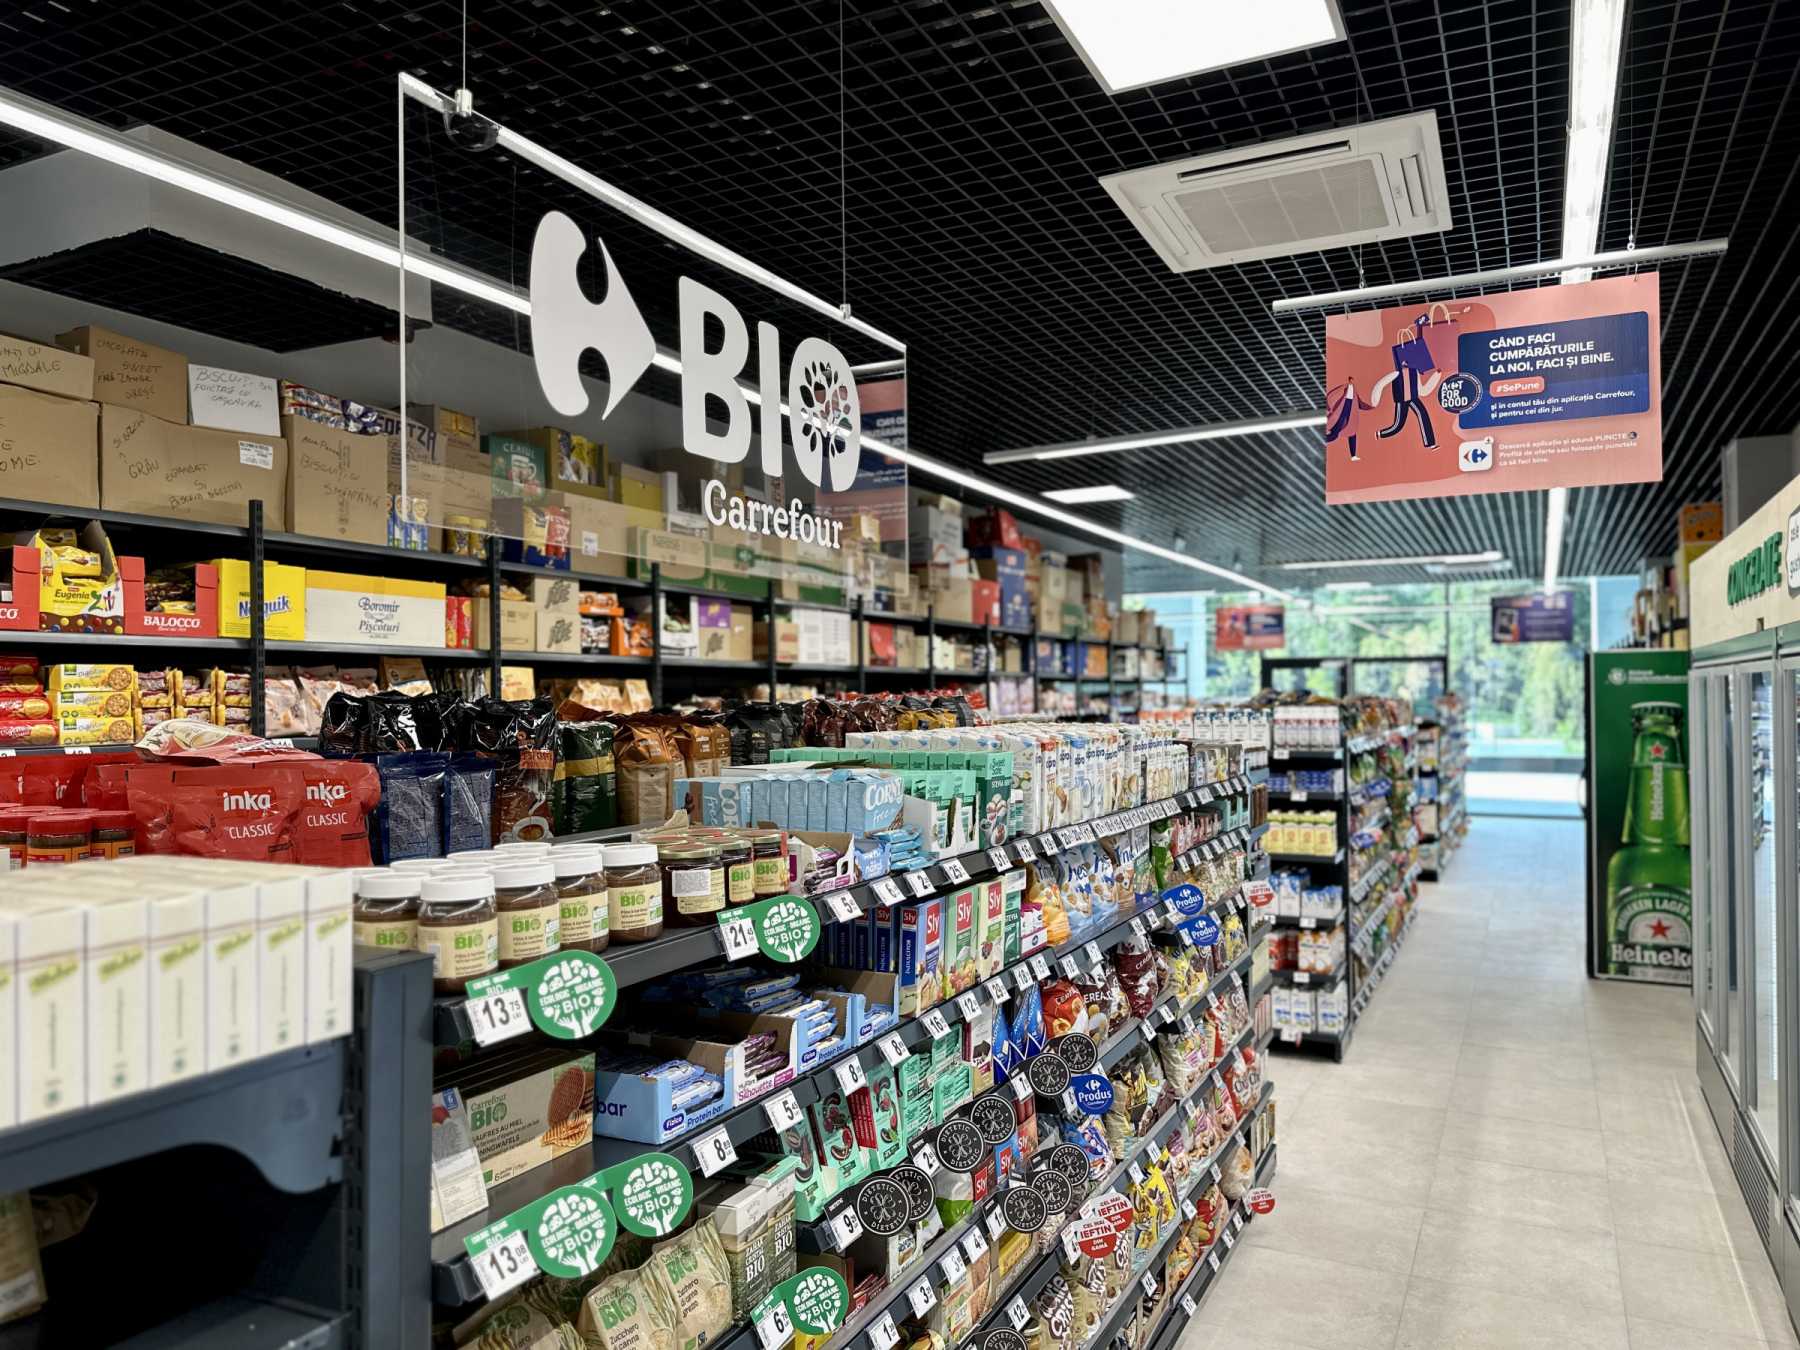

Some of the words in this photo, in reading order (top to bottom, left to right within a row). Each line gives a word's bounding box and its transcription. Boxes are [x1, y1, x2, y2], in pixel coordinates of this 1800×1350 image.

[1489, 336, 1525, 350] CÂND
[1527, 332, 1556, 345] FACI
[1489, 340, 1595, 363] CUMPĂRĂTURILE
[1490, 364, 1505, 375] LA
[1507, 362, 1533, 373] NOI,
[1536, 357, 1564, 370] FACI
[1565, 356, 1578, 369] ȘI
[1581, 352, 1614, 365] BINE.
[679, 275, 860, 492] BIO
[1495, 381, 1540, 393] #SePune
[1441, 389, 1460, 399] FOR
[1441, 396, 1468, 408] GOOD
[1498, 409, 1524, 419] pentru
[704, 479, 843, 550] Carrefour
[54, 589, 90, 600] Eugenia
[358, 597, 401, 613] Boromir
[144, 616, 200, 628] BALOCCO
[306, 780, 347, 803] nka
[223, 790, 272, 812] inka
[306, 812, 348, 828] CLASSIC
[228, 823, 274, 840] CLASSIC
[731, 868, 750, 882] BIO
[756, 862, 779, 875] BIO
[952, 865, 963, 881] 25
[885, 883, 897, 899] 6
[917, 874, 928, 890] 2
[619, 893, 646, 907] BIO
[841, 896, 853, 914] 5
[989, 890, 1002, 914] Sly
[1176, 894, 1202, 909] Produs
[560, 904, 589, 919] BIO
[903, 910, 917, 923] Sly
[957, 902, 972, 925] Sly
[512, 918, 542, 933] BIO
[927, 911, 940, 935] Sly
[375, 932, 408, 946] BIO
[729, 922, 748, 948] 21
[780, 930, 804, 945] BIO
[1191, 925, 1217, 940] Produs
[454, 934, 485, 950] BIO
[482, 996, 510, 1030] 13
[510, 1000, 521, 1011] 75
[563, 994, 591, 1014] BIO
[965, 997, 977, 1015] 12
[929, 1016, 944, 1033] 16
[891, 1039, 901, 1057] 8
[849, 1064, 858, 1083] 8
[1033, 1057, 1059, 1072] DIETETIC
[471, 1093, 507, 1112] Carrefour
[1078, 1089, 1112, 1103] Produs
[471, 1103, 507, 1131] BIO
[687, 1109, 712, 1128] Protein
[711, 1103, 724, 1117] bar
[783, 1099, 794, 1122] 5
[975, 1100, 1002, 1117] DIETETIC
[473, 1127, 500, 1142] AUFRES
[500, 1122, 510, 1133] AU
[941, 1124, 970, 1143] DIETETIC
[984, 1124, 1012, 1141] DIETETIC
[713, 1137, 725, 1162] 8
[922, 1151, 934, 1171] 2
[951, 1149, 980, 1170] DIETETIC
[1001, 1155, 1011, 1171] Sly
[976, 1175, 987, 1193] Sly
[1036, 1174, 1063, 1187] DIETETIC
[862, 1183, 896, 1203] DIETETIC
[1008, 1191, 1037, 1205] DIETETIC
[645, 1193, 671, 1213] BIO
[1098, 1200, 1129, 1217] IEFTIN
[843, 1214, 854, 1233] 9
[871, 1212, 905, 1231] DIETETIC
[1014, 1214, 1042, 1230] DIETETIC
[566, 1228, 593, 1252] BIO
[1080, 1223, 1112, 1240] IEFTIN
[746, 1238, 764, 1256] ZAHAR
[775, 1230, 793, 1256] BIO
[973, 1232, 983, 1250] 4
[489, 1245, 519, 1281] 13
[515, 1246, 526, 1257] 08
[666, 1252, 698, 1285] BIO
[746, 1255, 765, 1282] BIO
[594, 1283, 631, 1306] Carrefour
[919, 1285, 930, 1305] 3
[598, 1293, 638, 1330] BIO
[812, 1300, 832, 1317] BIO
[1013, 1304, 1025, 1322] 12
[773, 1311, 785, 1334] 6
[609, 1323, 640, 1347] Zucchero
[883, 1322, 893, 1342] 1
[988, 1333, 1017, 1348] DIETETIC
[619, 1334, 640, 1349] canna
